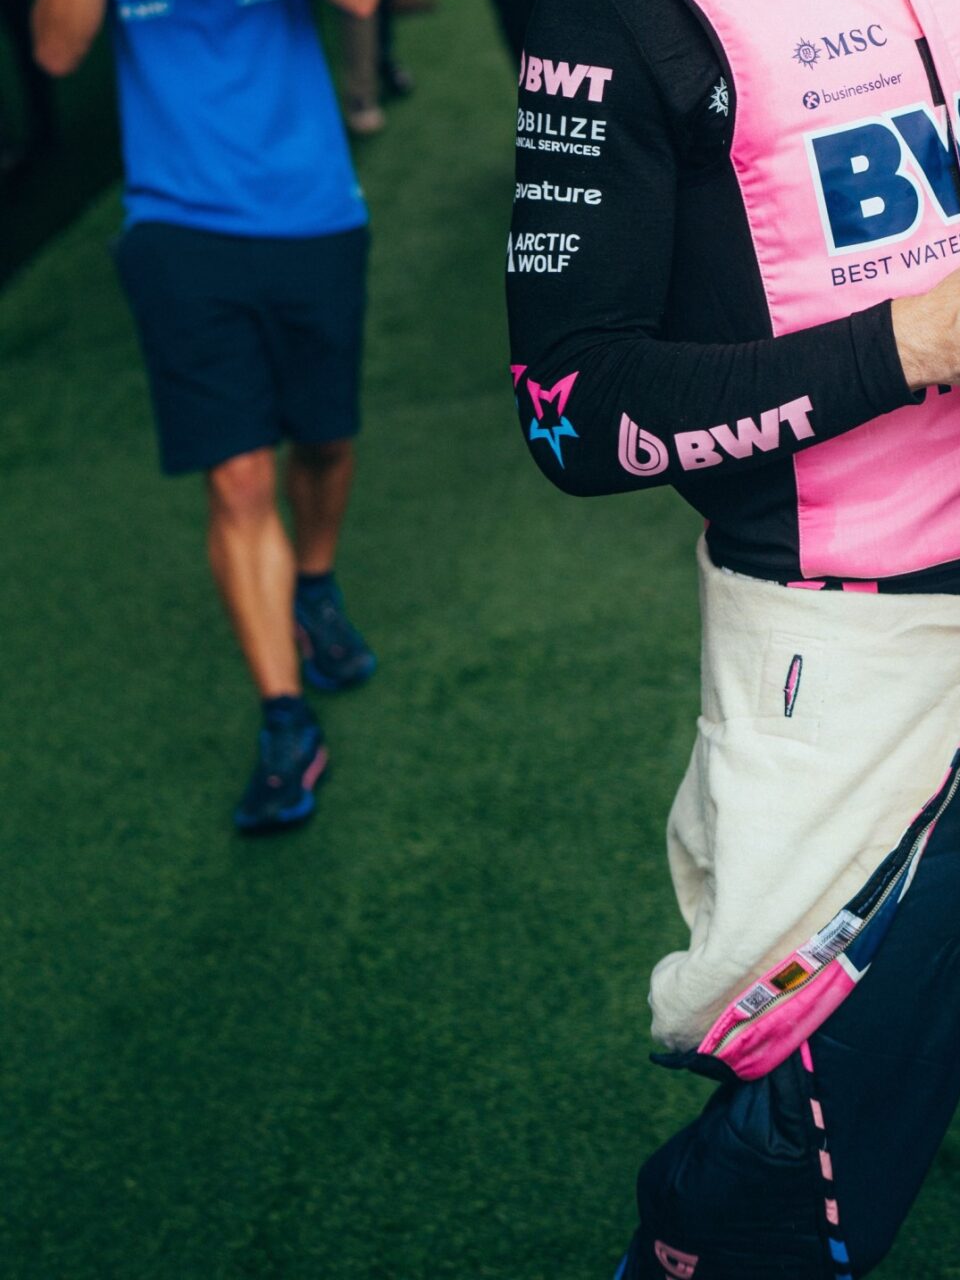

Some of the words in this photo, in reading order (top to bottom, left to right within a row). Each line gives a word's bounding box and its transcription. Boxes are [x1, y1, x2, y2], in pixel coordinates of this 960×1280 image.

[820, 24, 888, 60] MSC
[525, 55, 613, 102] BWT
[821, 73, 902, 104] businessolver
[517, 107, 607, 141] OBILIZE
[538, 139, 601, 157] SERVICES
[514, 232, 581, 253] ARCTIC
[518, 254, 571, 273] WOLF
[831, 256, 893, 287] BEST
[673, 394, 816, 472] BWT
